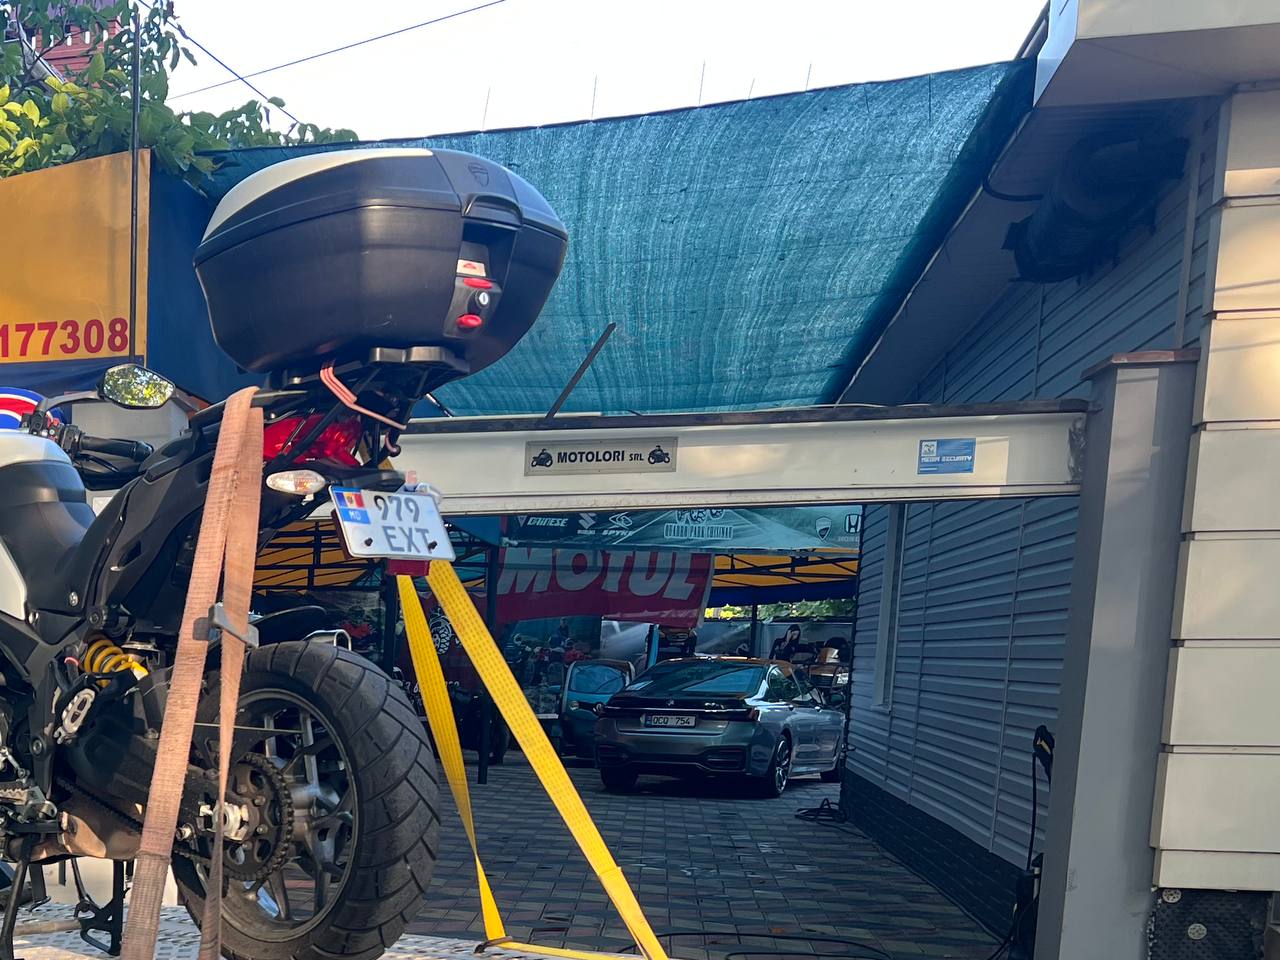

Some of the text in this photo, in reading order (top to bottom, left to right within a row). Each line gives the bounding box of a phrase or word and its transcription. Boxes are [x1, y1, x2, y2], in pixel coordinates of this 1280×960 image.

[557, 450, 644, 464] MOTOLORI SRL
[373, 495, 420, 523] 979
[382, 526, 432, 554] EXT
[496, 547, 699, 600] MOTUL
[675, 716, 691, 725] 754
